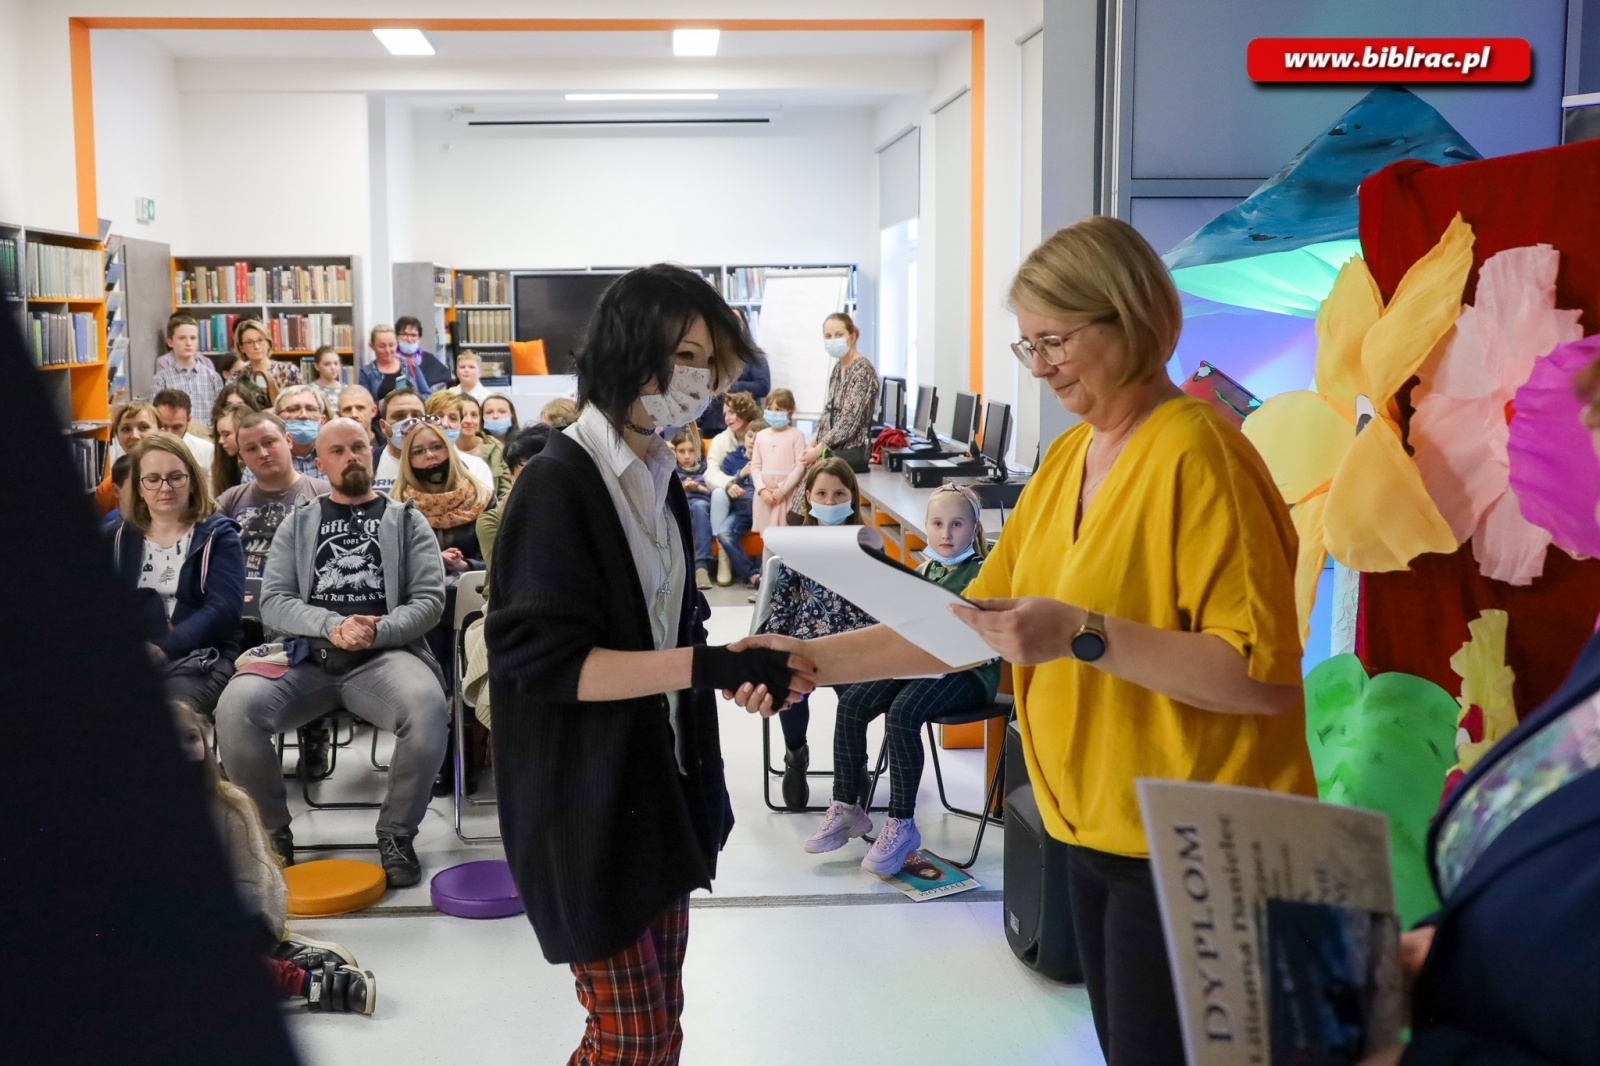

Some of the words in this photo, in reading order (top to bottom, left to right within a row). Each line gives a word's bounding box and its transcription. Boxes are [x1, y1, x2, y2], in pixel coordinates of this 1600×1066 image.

[330, 593, 345, 602] Kill
[346, 593, 367, 602] Rock
[368, 592, 376, 600] &
[1174, 824, 1232, 1042] DYPLOM
